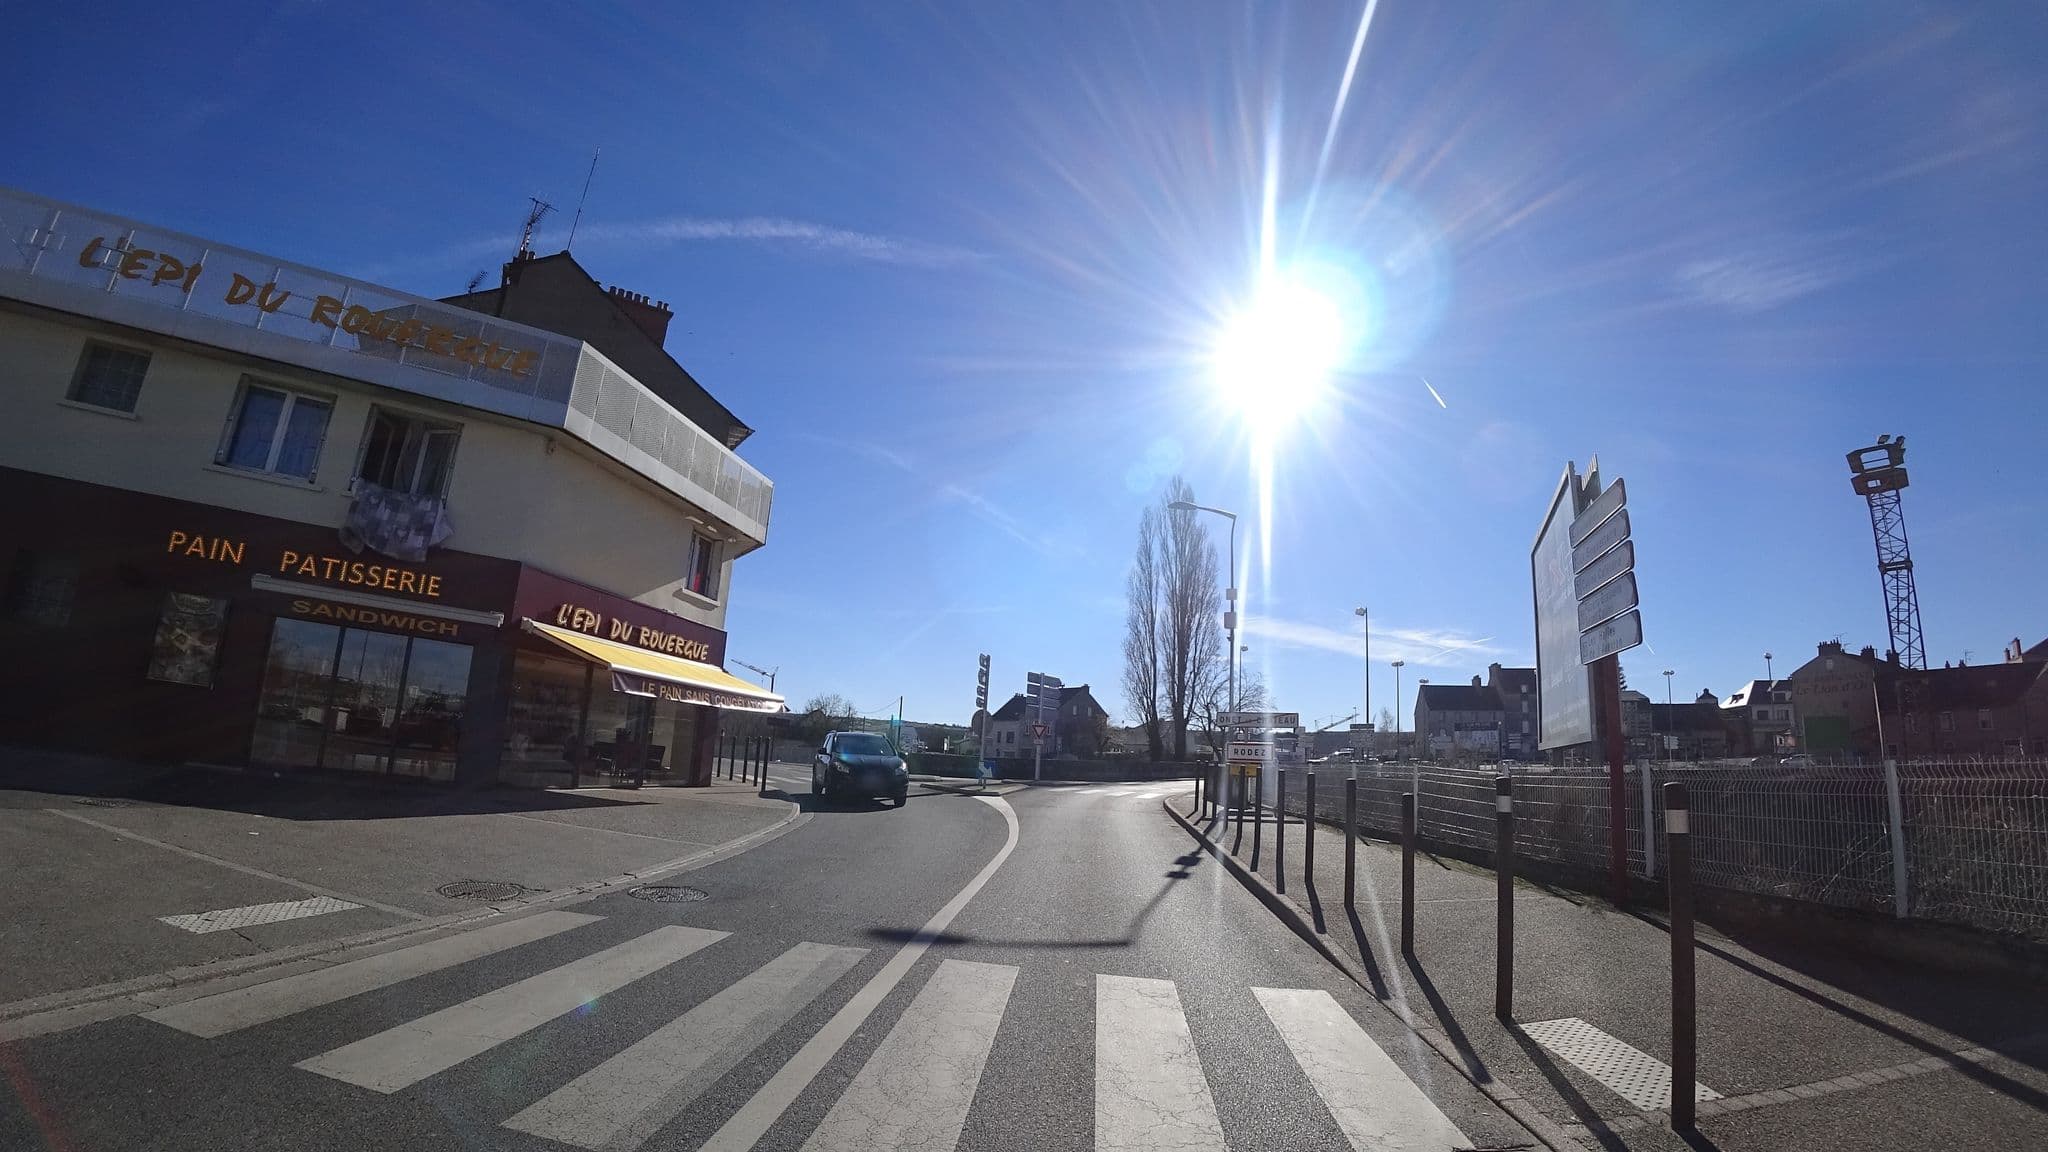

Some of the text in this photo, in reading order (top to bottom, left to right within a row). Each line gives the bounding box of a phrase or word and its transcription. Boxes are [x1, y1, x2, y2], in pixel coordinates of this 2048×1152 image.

[79, 236, 538, 379] L'EPI DU ROUERGUE
[167, 530, 443, 598] PAIN PATISSERIE
[291, 599, 460, 637] SANDWICH
[557, 603, 709, 661] L'EPI DU ROUERGUE
[641, 681, 655, 695] LE
[659, 684, 682, 701] PAIN
[685, 690, 710, 705] SANS
[1233, 748, 1266, 757] RODEZ
